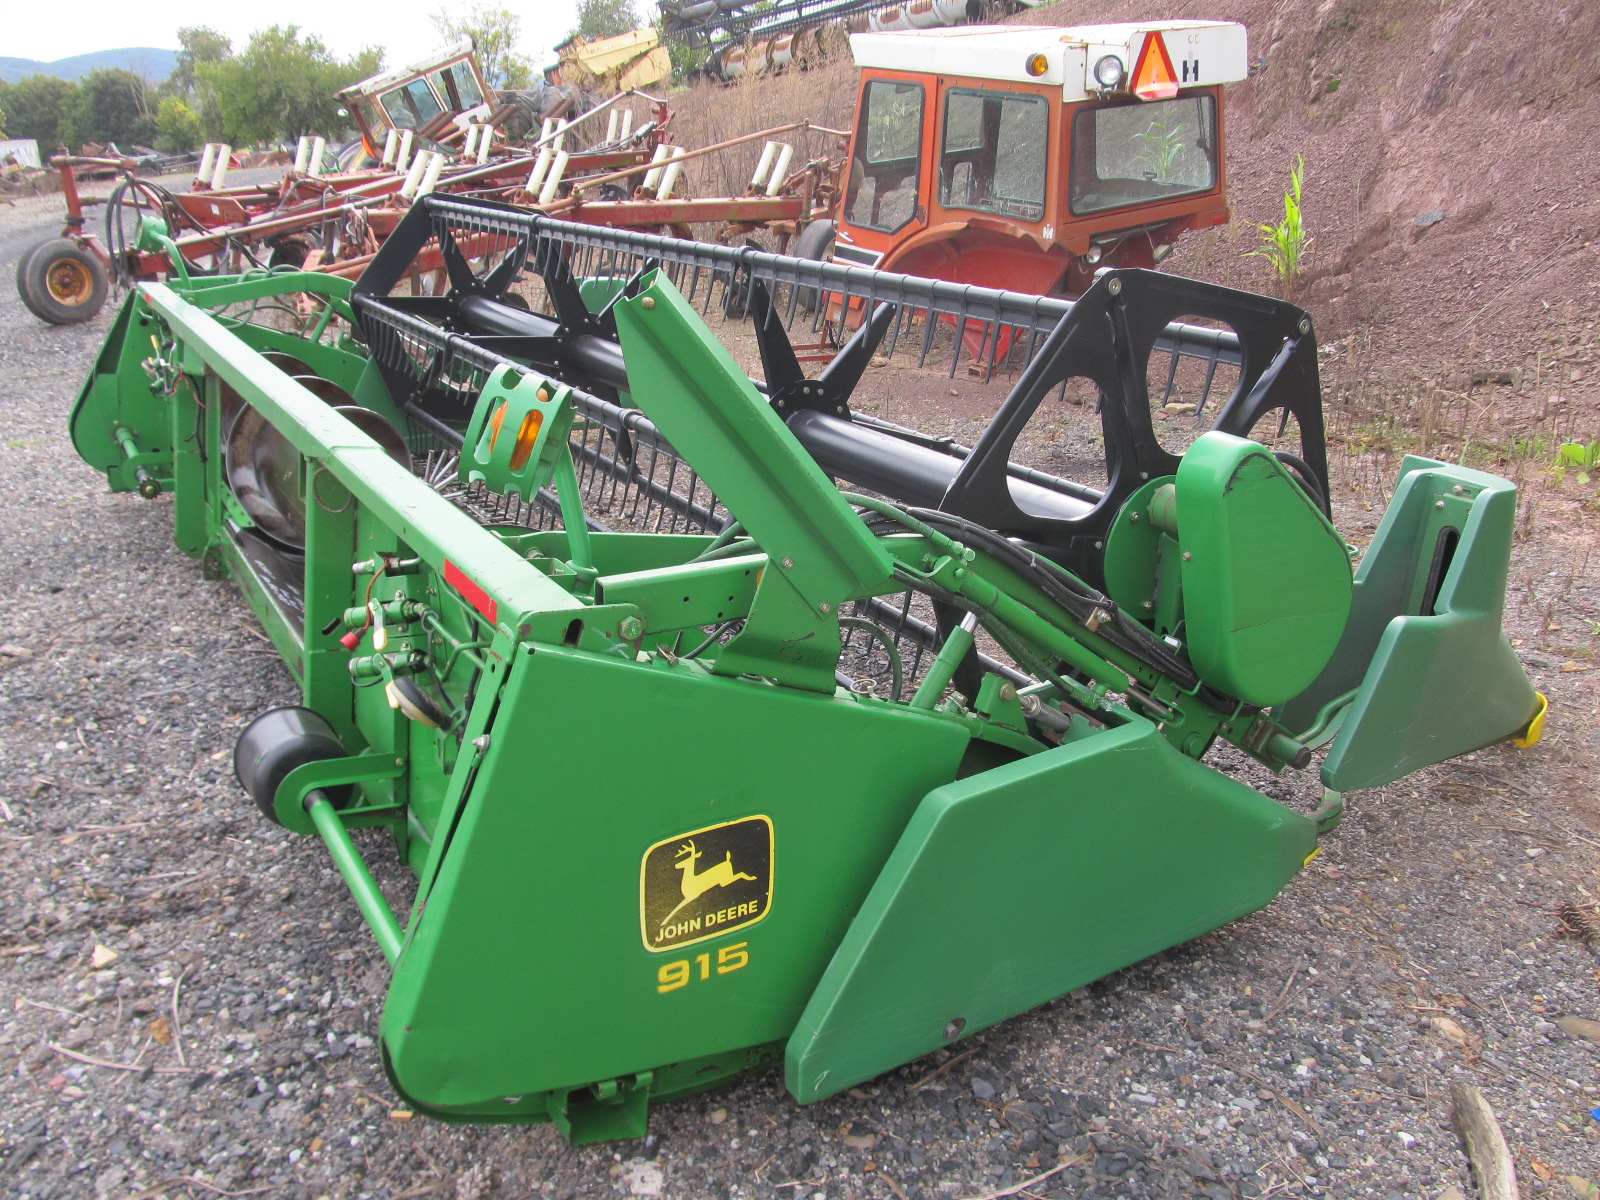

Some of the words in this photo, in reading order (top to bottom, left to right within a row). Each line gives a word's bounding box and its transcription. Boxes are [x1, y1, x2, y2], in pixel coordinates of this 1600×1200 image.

[654, 917, 701, 943] JOHN
[705, 900, 759, 928] DEERE
[657, 941, 749, 994] 915
